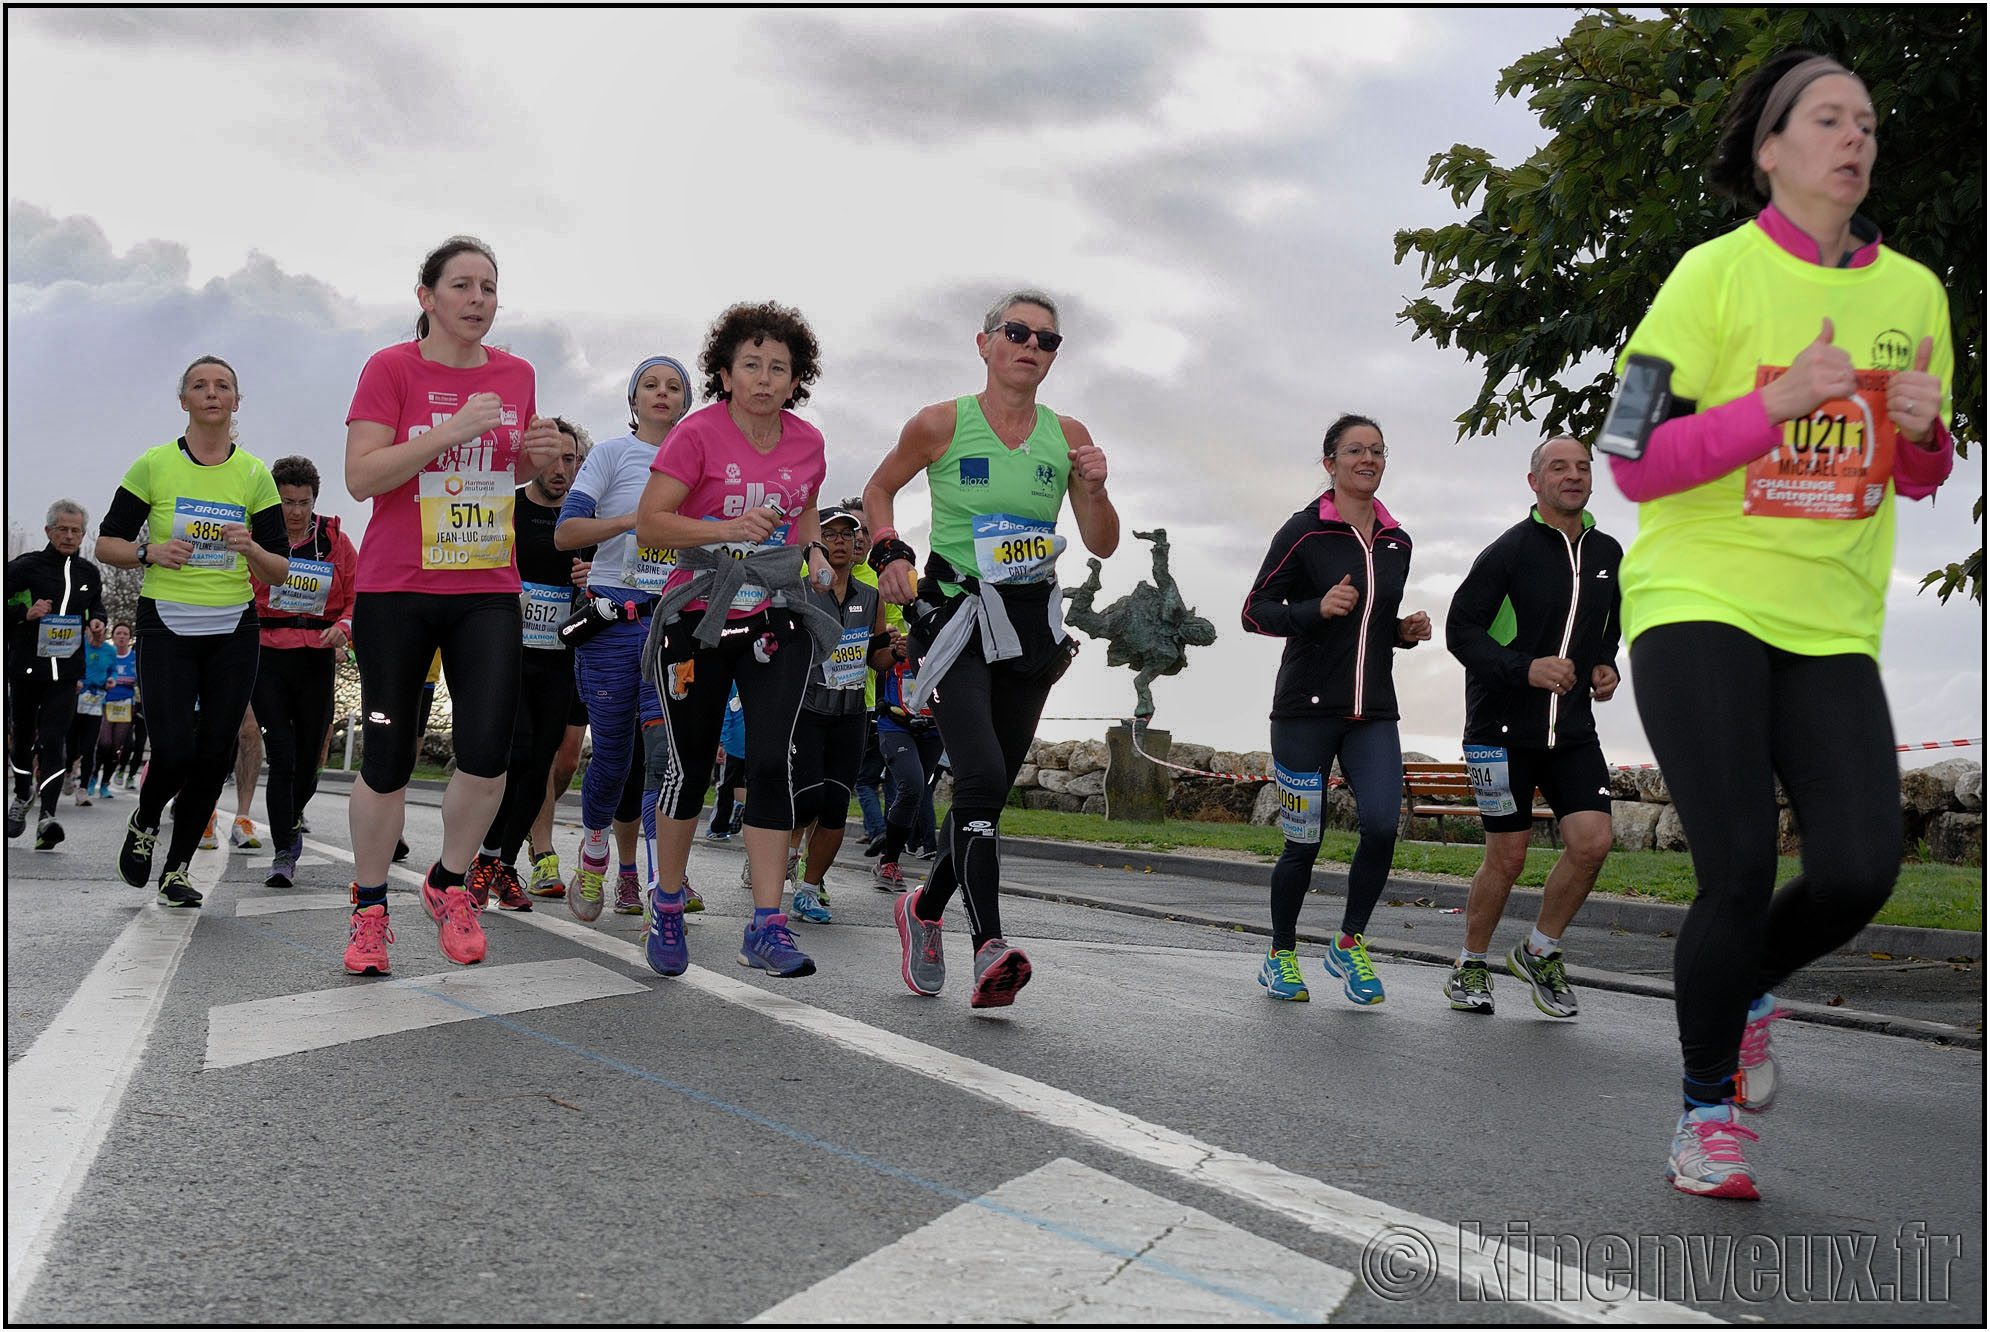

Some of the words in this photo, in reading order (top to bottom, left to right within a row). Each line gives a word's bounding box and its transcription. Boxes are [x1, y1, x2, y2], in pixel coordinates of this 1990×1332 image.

[1757, 478, 1836, 491] CHALLENGE
[1766, 488, 1855, 502] Entreprises
[194, 505, 243, 519] BROOKS
[450, 503, 482, 528] 571
[488, 510, 494, 528] A
[192, 520, 227, 542] 385
[436, 531, 478, 543] JEAN-LUC
[190, 553, 224, 561] ARATHON
[429, 546, 470, 564] Duo
[1001, 535, 1047, 565] 3816
[290, 561, 332, 574] BROOKS
[636, 563, 660, 575] SABINE
[1008, 564, 1027, 577] CATY
[285, 574, 318, 593] 4080
[530, 588, 571, 600] BROOKS
[525, 602, 558, 624] 6512
[51, 627, 72, 640] 5417
[841, 630, 869, 641] ROOKS
[834, 645, 862, 664] 3895
[1276, 768, 1319, 787] BROOKS
